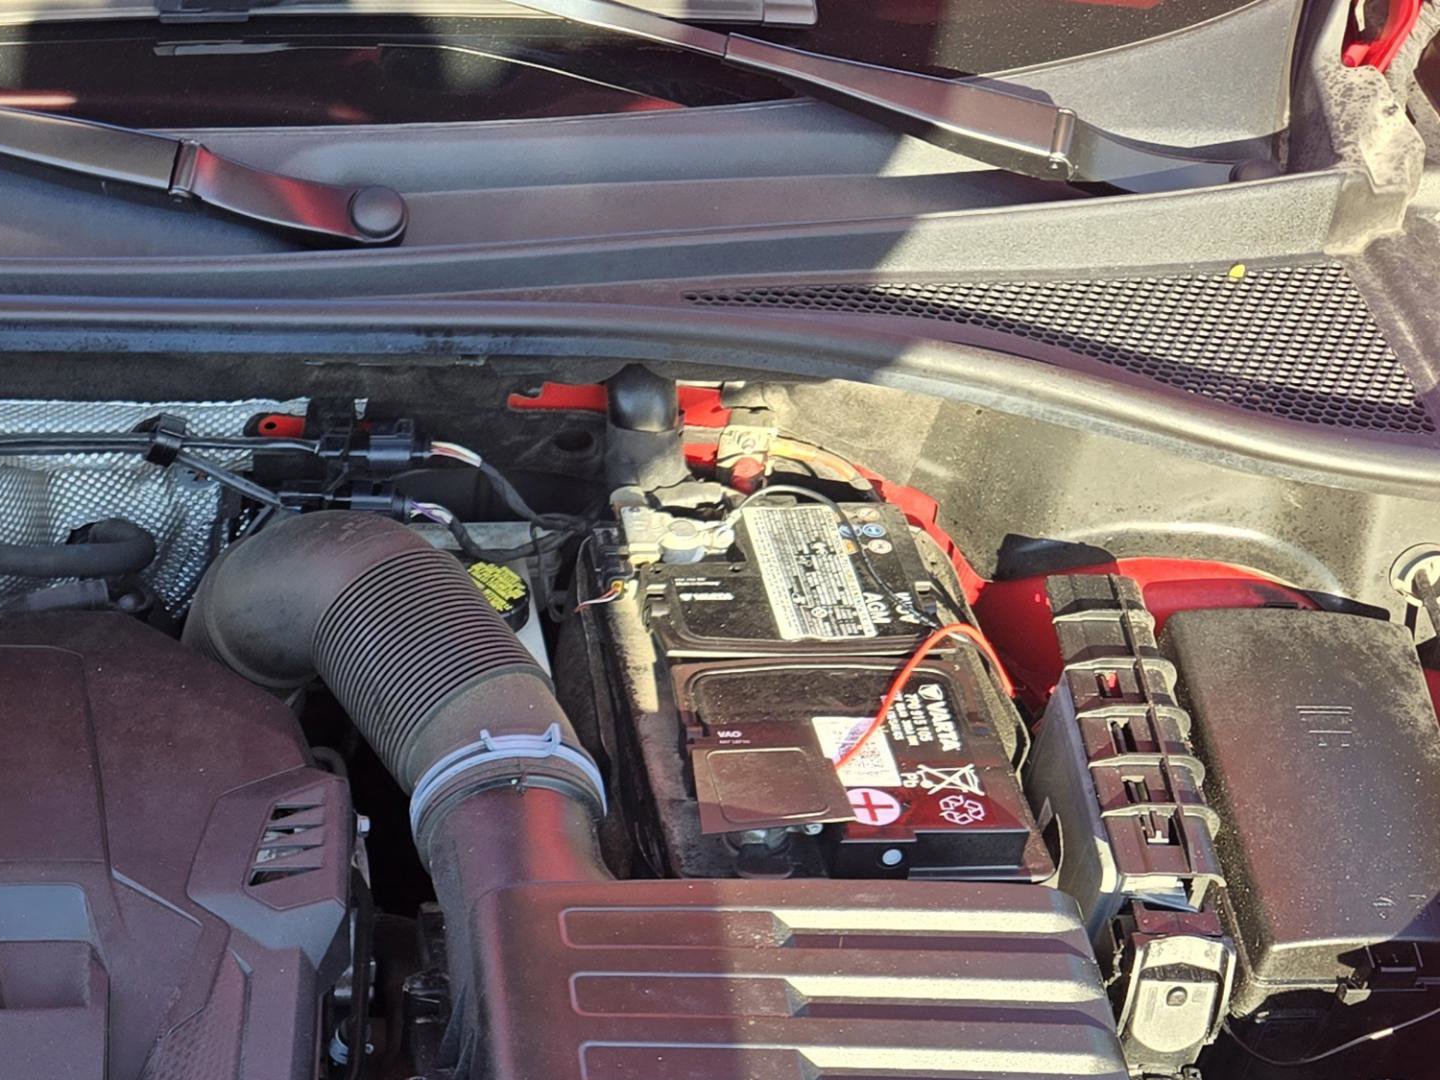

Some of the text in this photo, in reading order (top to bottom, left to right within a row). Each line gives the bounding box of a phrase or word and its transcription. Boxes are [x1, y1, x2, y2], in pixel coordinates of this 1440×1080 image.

[862, 592, 892, 624] AGM
[909, 710, 927, 725] 915
[926, 700, 961, 752] VARTA
[916, 726, 933, 741] 105
